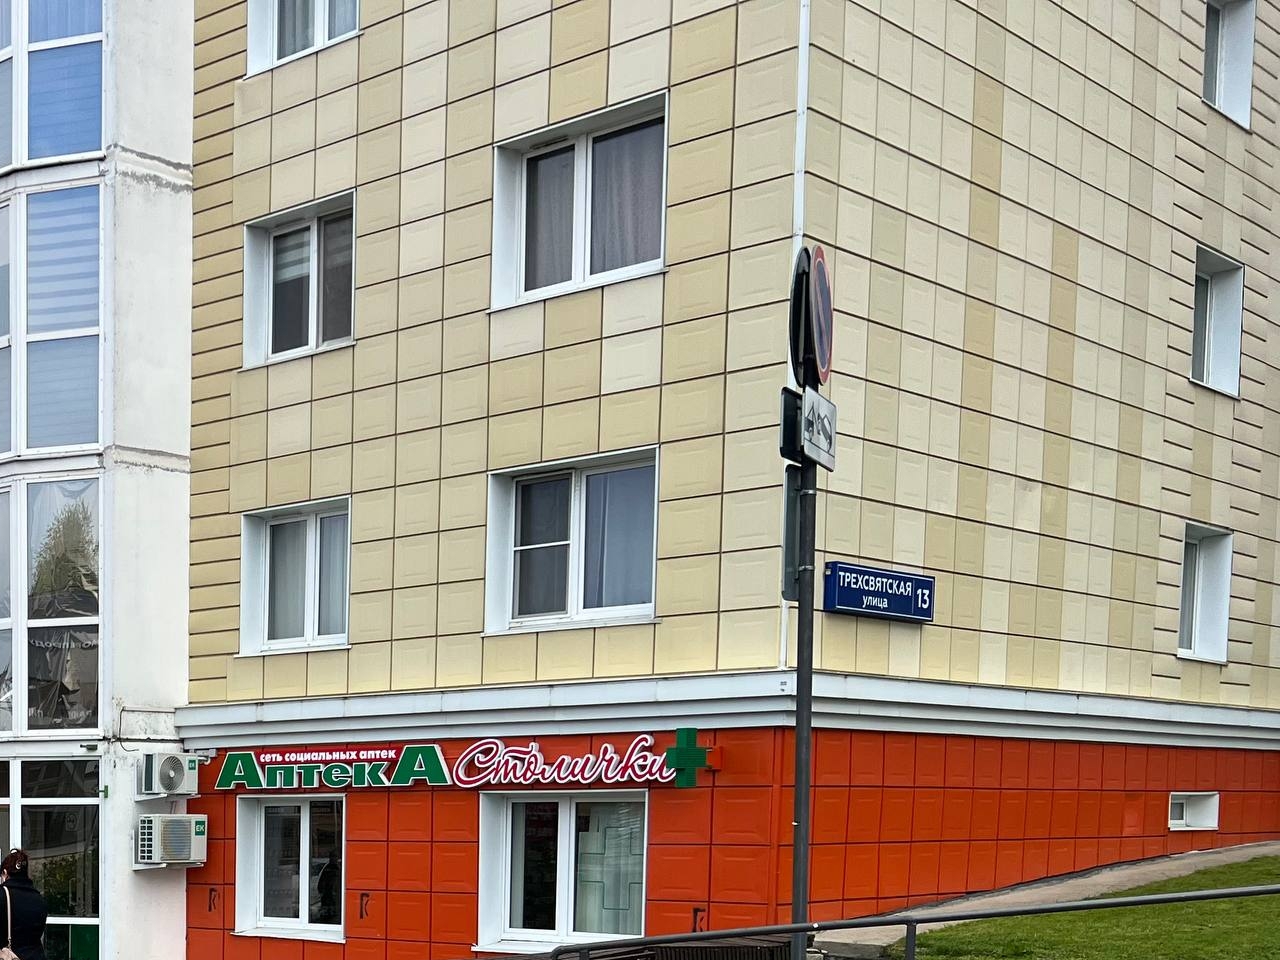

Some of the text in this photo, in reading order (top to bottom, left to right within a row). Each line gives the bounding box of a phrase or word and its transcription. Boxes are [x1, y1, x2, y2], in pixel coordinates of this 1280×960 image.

[839, 571, 912, 596] ТРЕХСВЯТСКАЯ
[862, 595, 888, 608] улица
[916, 588, 930, 609] 13
[260, 749, 397, 763] сеть социальных аптек
[453, 735, 678, 787] Столички
